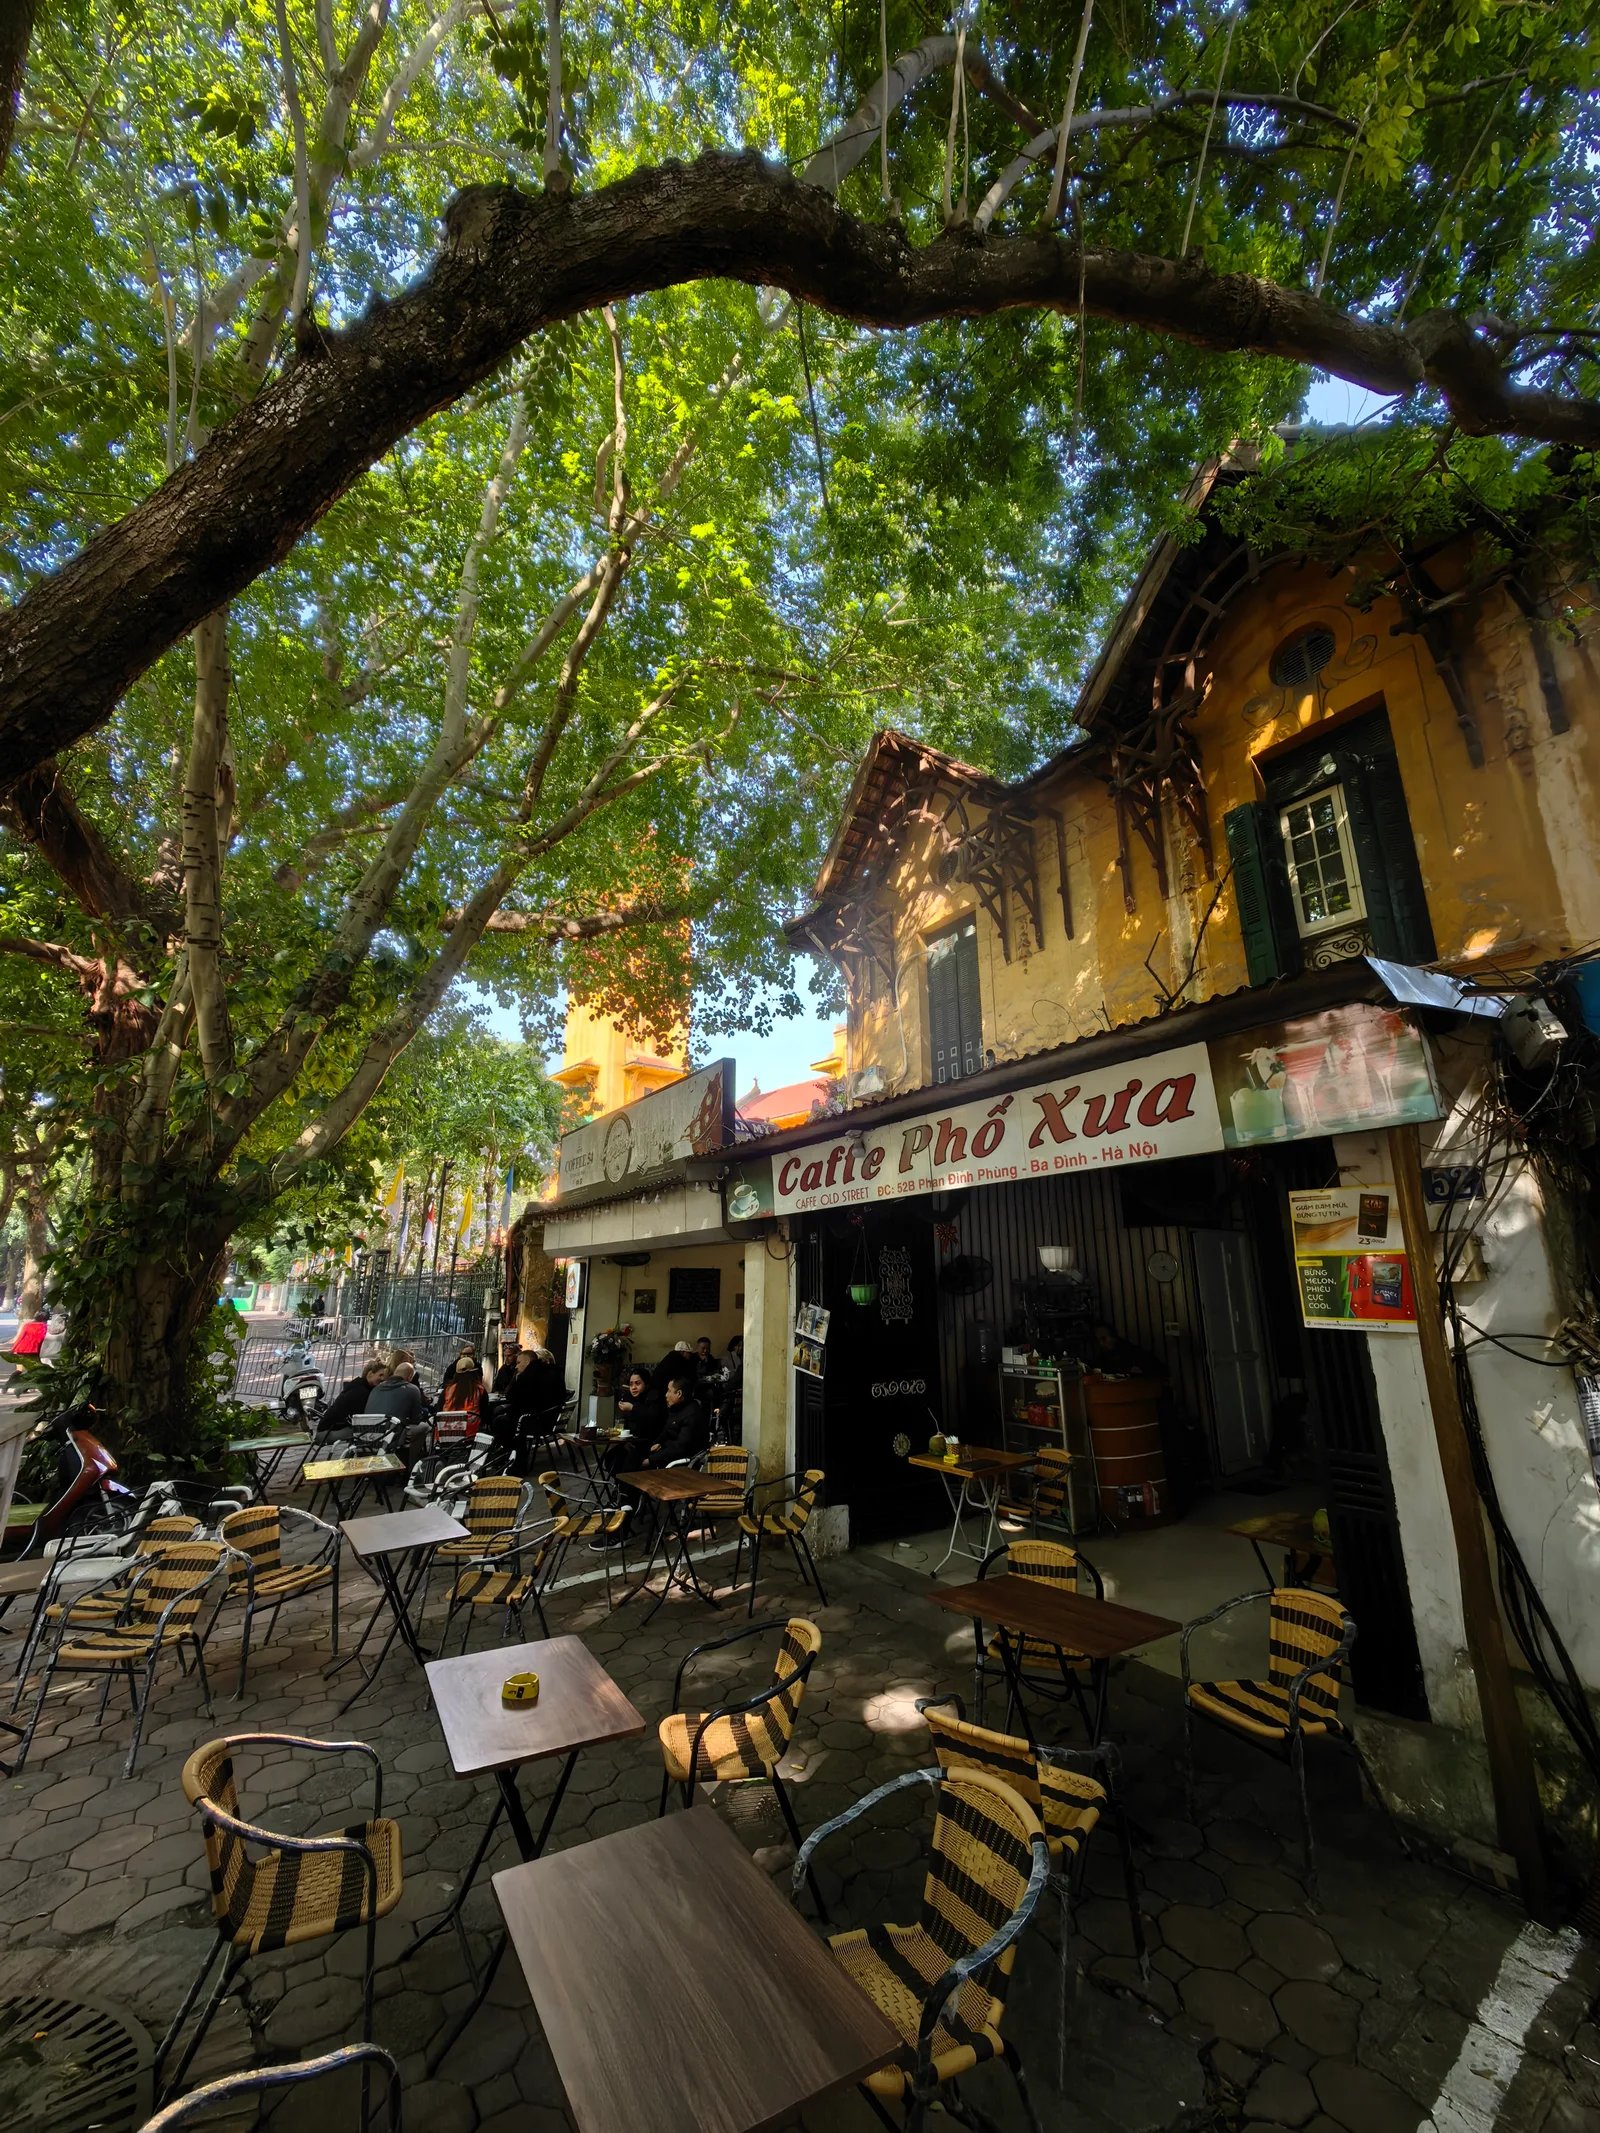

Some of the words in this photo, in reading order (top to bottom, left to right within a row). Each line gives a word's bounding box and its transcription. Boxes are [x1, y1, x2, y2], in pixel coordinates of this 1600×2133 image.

[899, 1095, 1015, 1174] Phố
[1028, 1073, 1197, 1149] Xưa
[877, 1184, 895, 1198] ĐC:
[897, 1181, 915, 1194] 52B
[918, 1177, 945, 1191] Phan
[977, 1165, 1018, 1182] Phùng
[1030, 1159, 1049, 1174] Ba
[1053, 1152, 1088, 1170] Đình
[1101, 1145, 1124, 1162] Hà
[796, 1196, 817, 1210] CAFFE
[820, 1193, 840, 1206] OLD
[842, 1187, 869, 1204] STREET
[1305, 1277, 1337, 1286] MELON,
[1308, 1302, 1332, 1310] COOL
